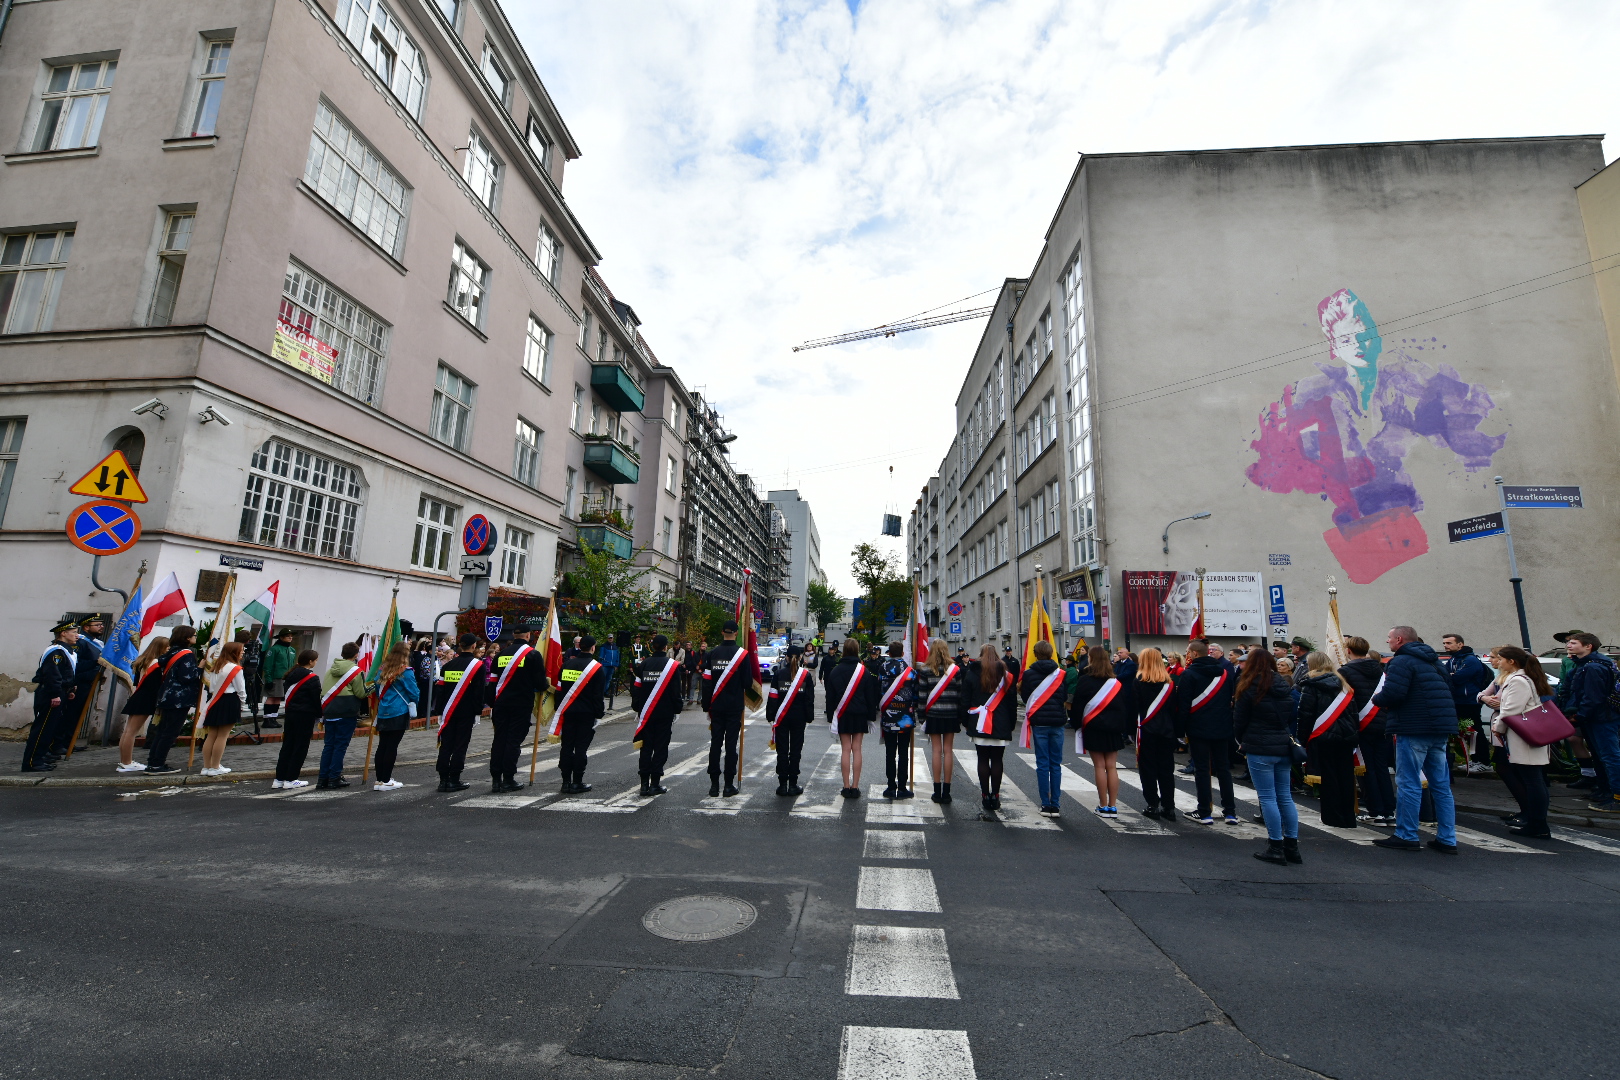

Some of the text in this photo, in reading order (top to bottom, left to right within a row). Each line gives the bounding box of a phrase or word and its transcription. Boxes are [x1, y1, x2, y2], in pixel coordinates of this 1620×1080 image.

[277, 320, 319, 350] POKOJE
[1507, 493, 1580, 502] Strzałkowskiego
[1454, 522, 1497, 535] Mansfelda
[1272, 588, 1280, 604] P
[1074, 604, 1089, 622] P
[488, 627, 499, 636] 23
[952, 624, 959, 632] P
